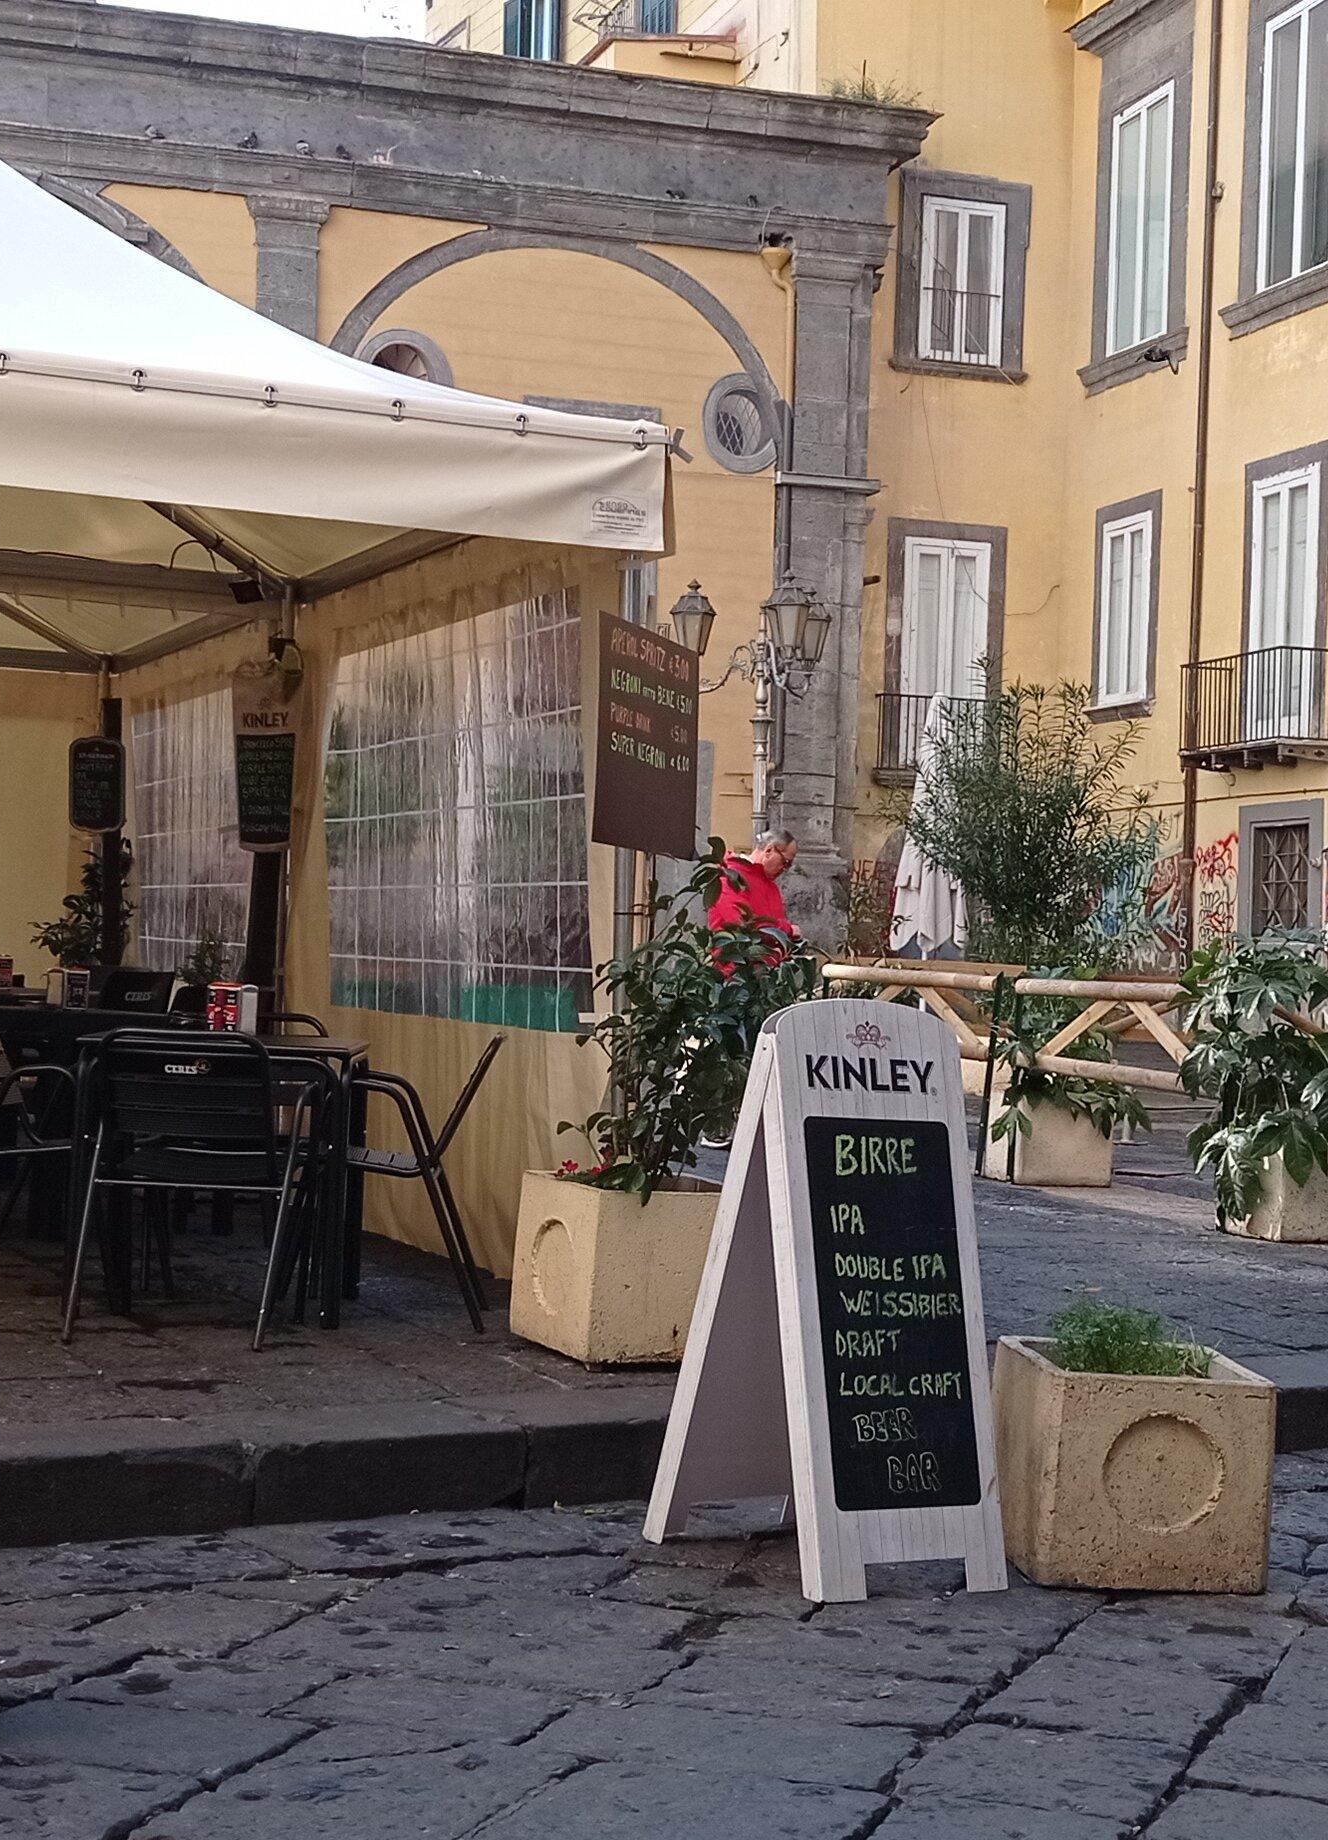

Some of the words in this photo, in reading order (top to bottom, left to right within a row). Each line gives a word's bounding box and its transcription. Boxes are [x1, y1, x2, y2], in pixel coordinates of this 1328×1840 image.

[611, 668, 641, 694] NEGRONI
[657, 685, 675, 709] BENE
[243, 713, 289, 728] KINLEY
[611, 731, 635, 757] SUPER
[637, 742, 666, 770] NEGRONI
[164, 1064, 198, 1075] CERES
[805, 1054, 935, 1095] KINLEY
[835, 1134, 917, 1177] BIRRE
[829, 1203, 866, 1236] IPA
[835, 1252, 904, 1281] DOUBLE
[912, 1252, 947, 1280] IPA
[835, 1328, 901, 1358] DRAFT
[840, 1372, 905, 1397] LOCAL
[909, 1372, 962, 1400] CRAFT
[852, 1407, 918, 1442] BEER
[887, 1452, 941, 1493] BAR
